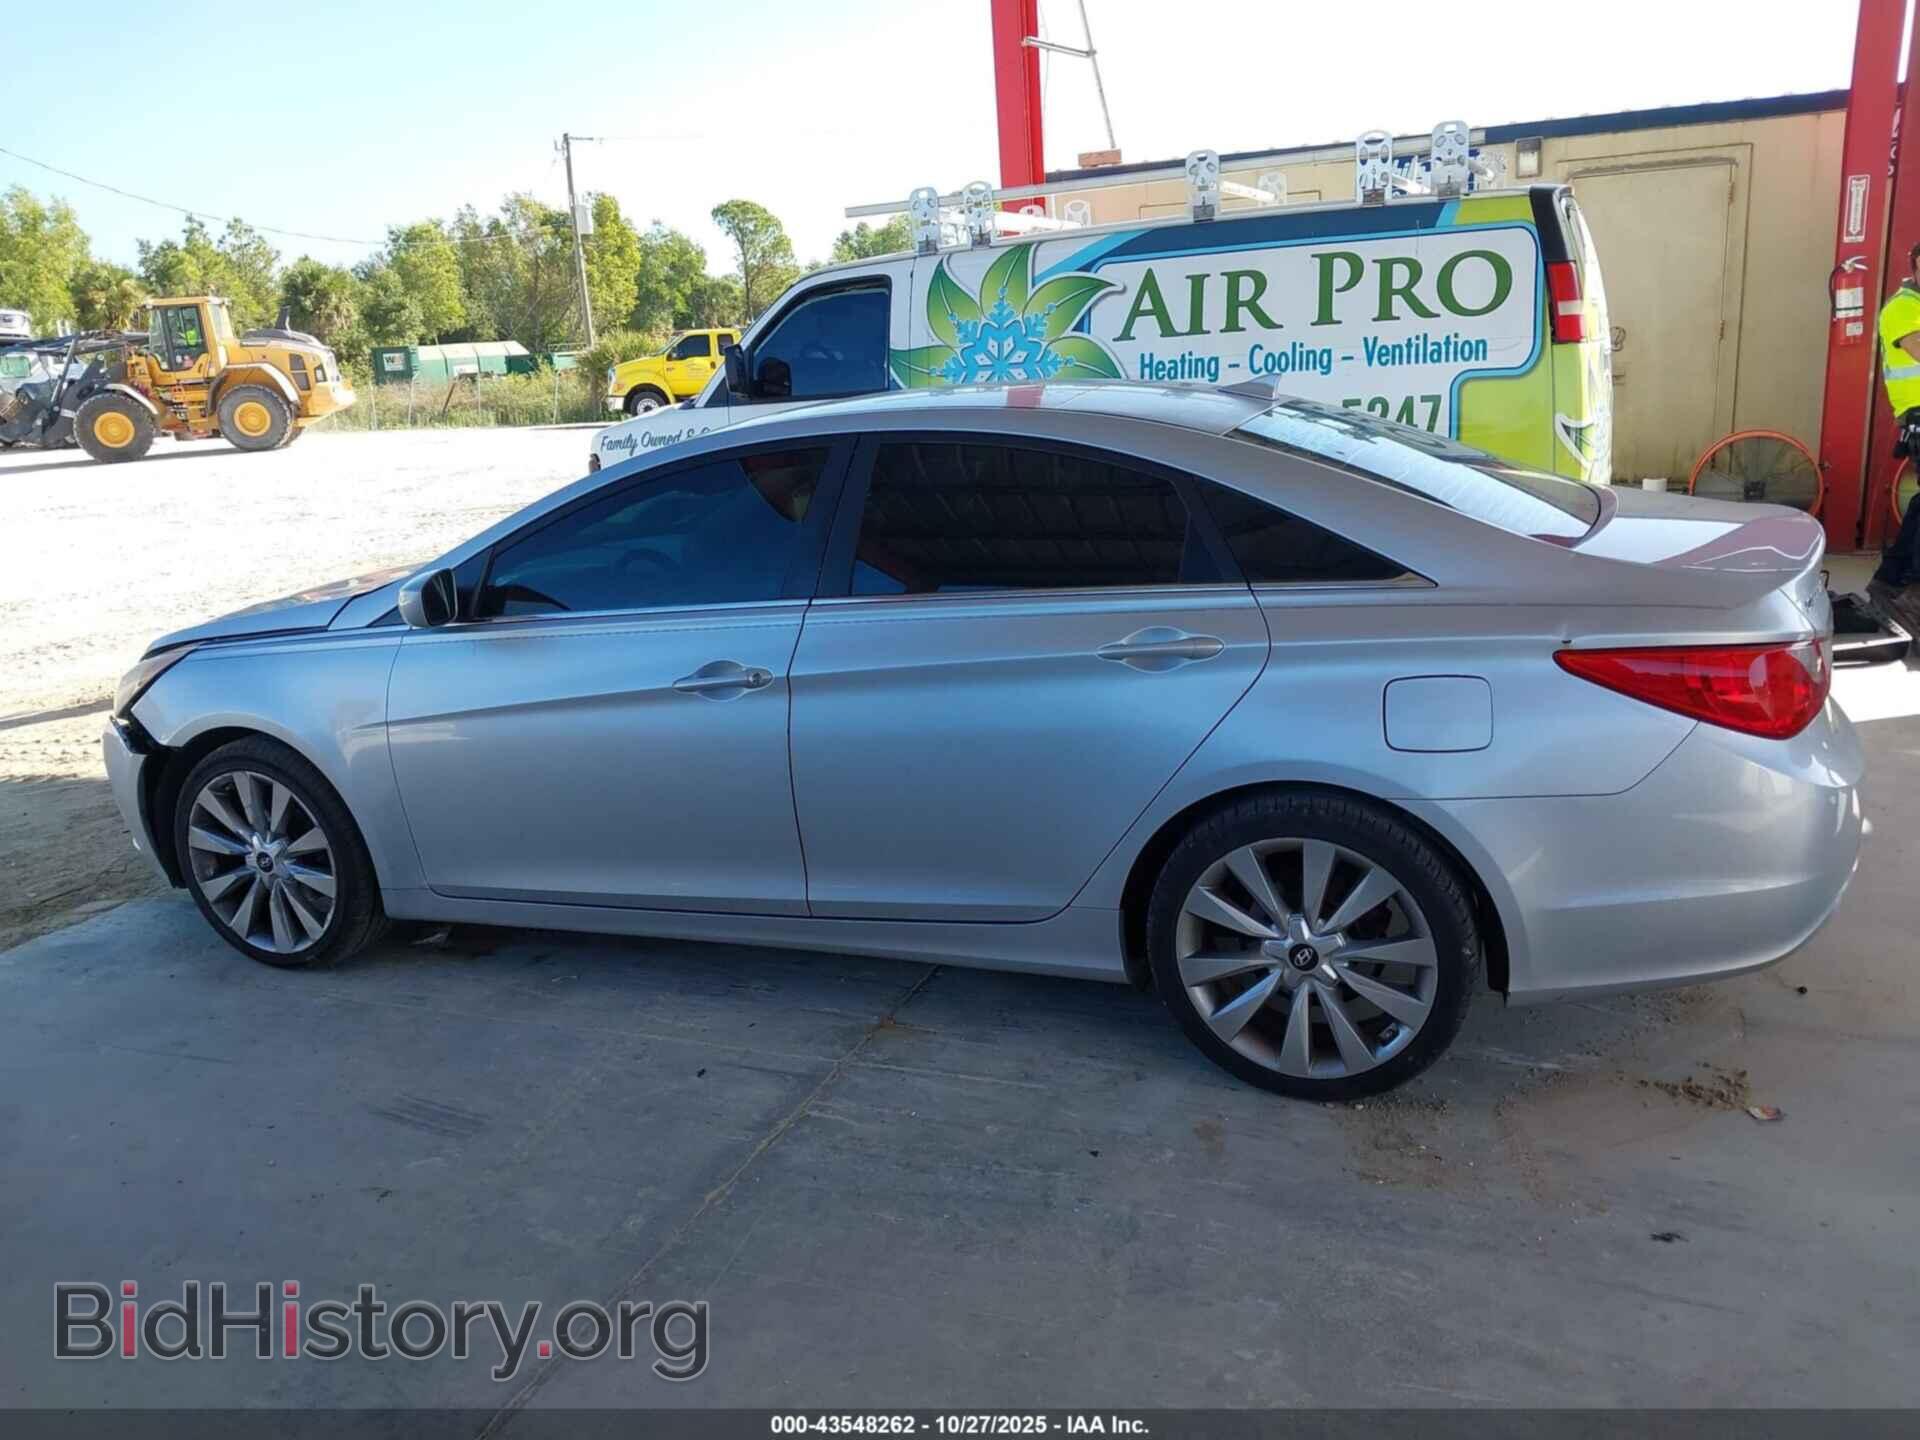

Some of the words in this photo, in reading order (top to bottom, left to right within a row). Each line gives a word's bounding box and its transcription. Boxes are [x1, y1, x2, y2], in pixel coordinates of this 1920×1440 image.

[1112, 267, 1284, 342] AIR
[1310, 249, 1513, 326] PRO
[1139, 351, 1219, 382] Heating
[1249, 342, 1332, 375] Cooling
[1363, 332, 1488, 367] Ventilation
[600, 432, 639, 456] Family
[640, 430, 682, 448] Owned
